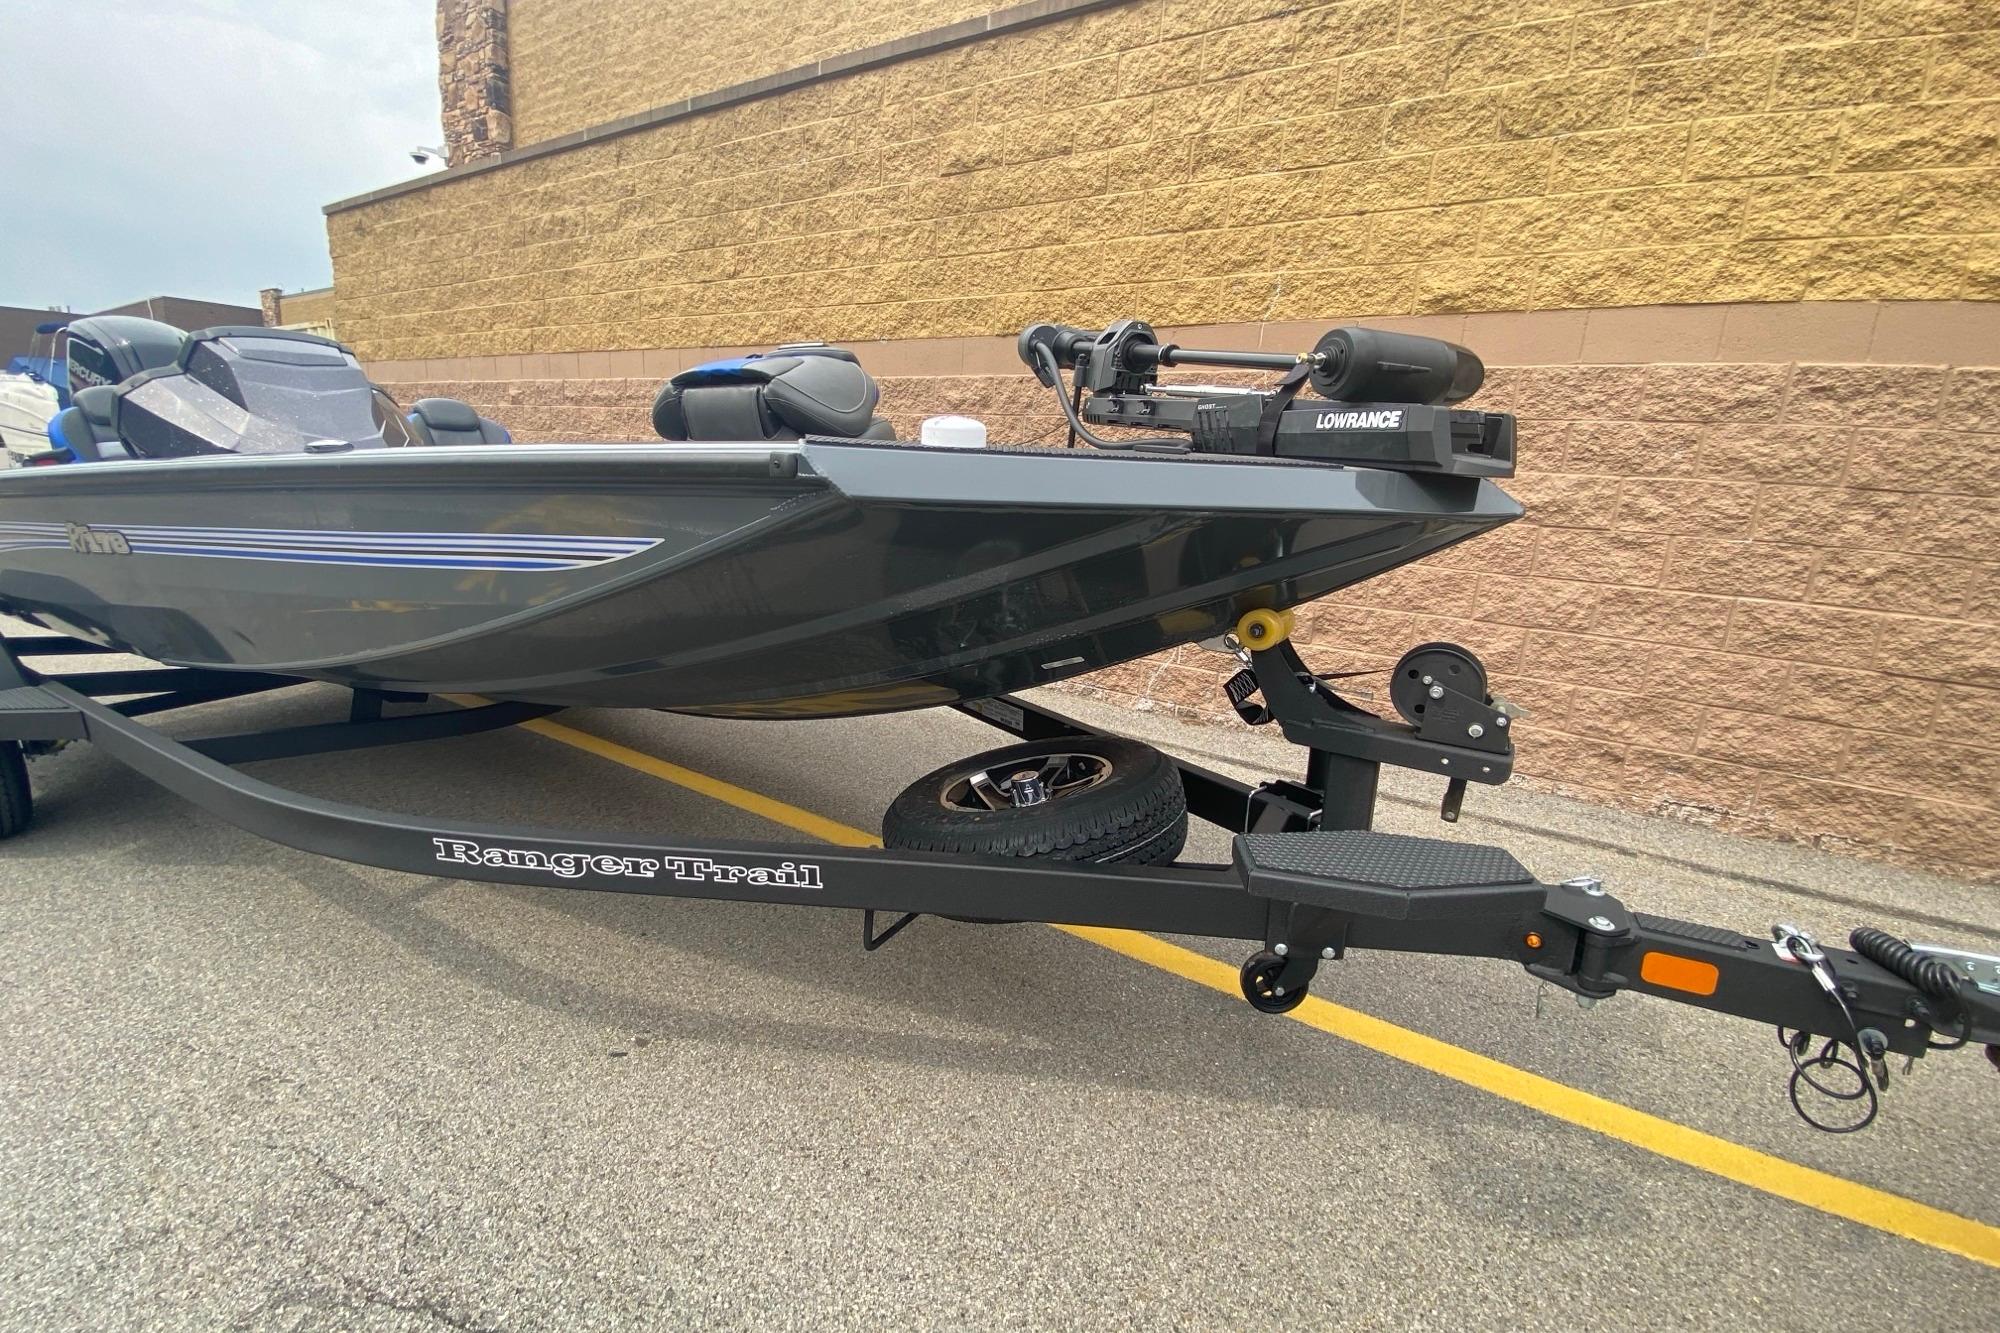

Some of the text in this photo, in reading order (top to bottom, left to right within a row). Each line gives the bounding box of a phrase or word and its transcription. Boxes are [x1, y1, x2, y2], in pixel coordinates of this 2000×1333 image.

[69, 357, 113, 386] ERCURY
[1315, 410, 1402, 429] LOWRANCE
[433, 838, 823, 889] Ranger Trail
